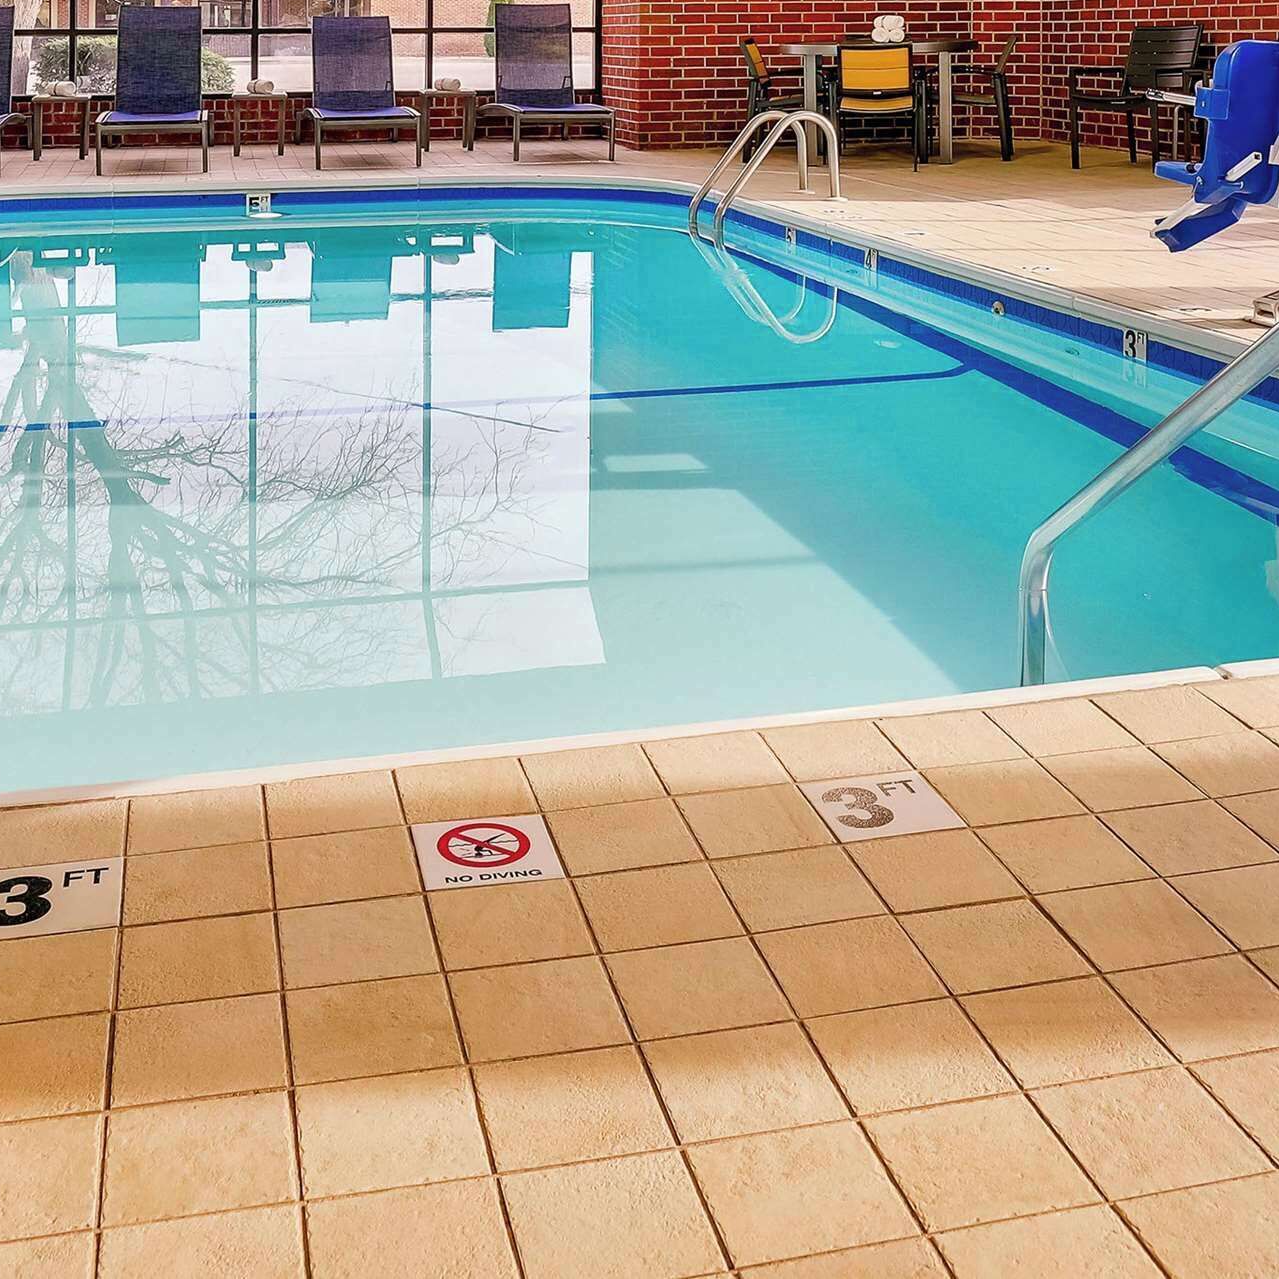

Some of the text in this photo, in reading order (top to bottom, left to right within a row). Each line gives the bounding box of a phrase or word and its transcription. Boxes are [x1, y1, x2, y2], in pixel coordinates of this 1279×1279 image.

[1125, 329, 1145, 358] 3 FT
[821, 779, 916, 829] 3 FT
[63, 867, 109, 888] FT
[445, 869, 543, 884] NO DIVING
